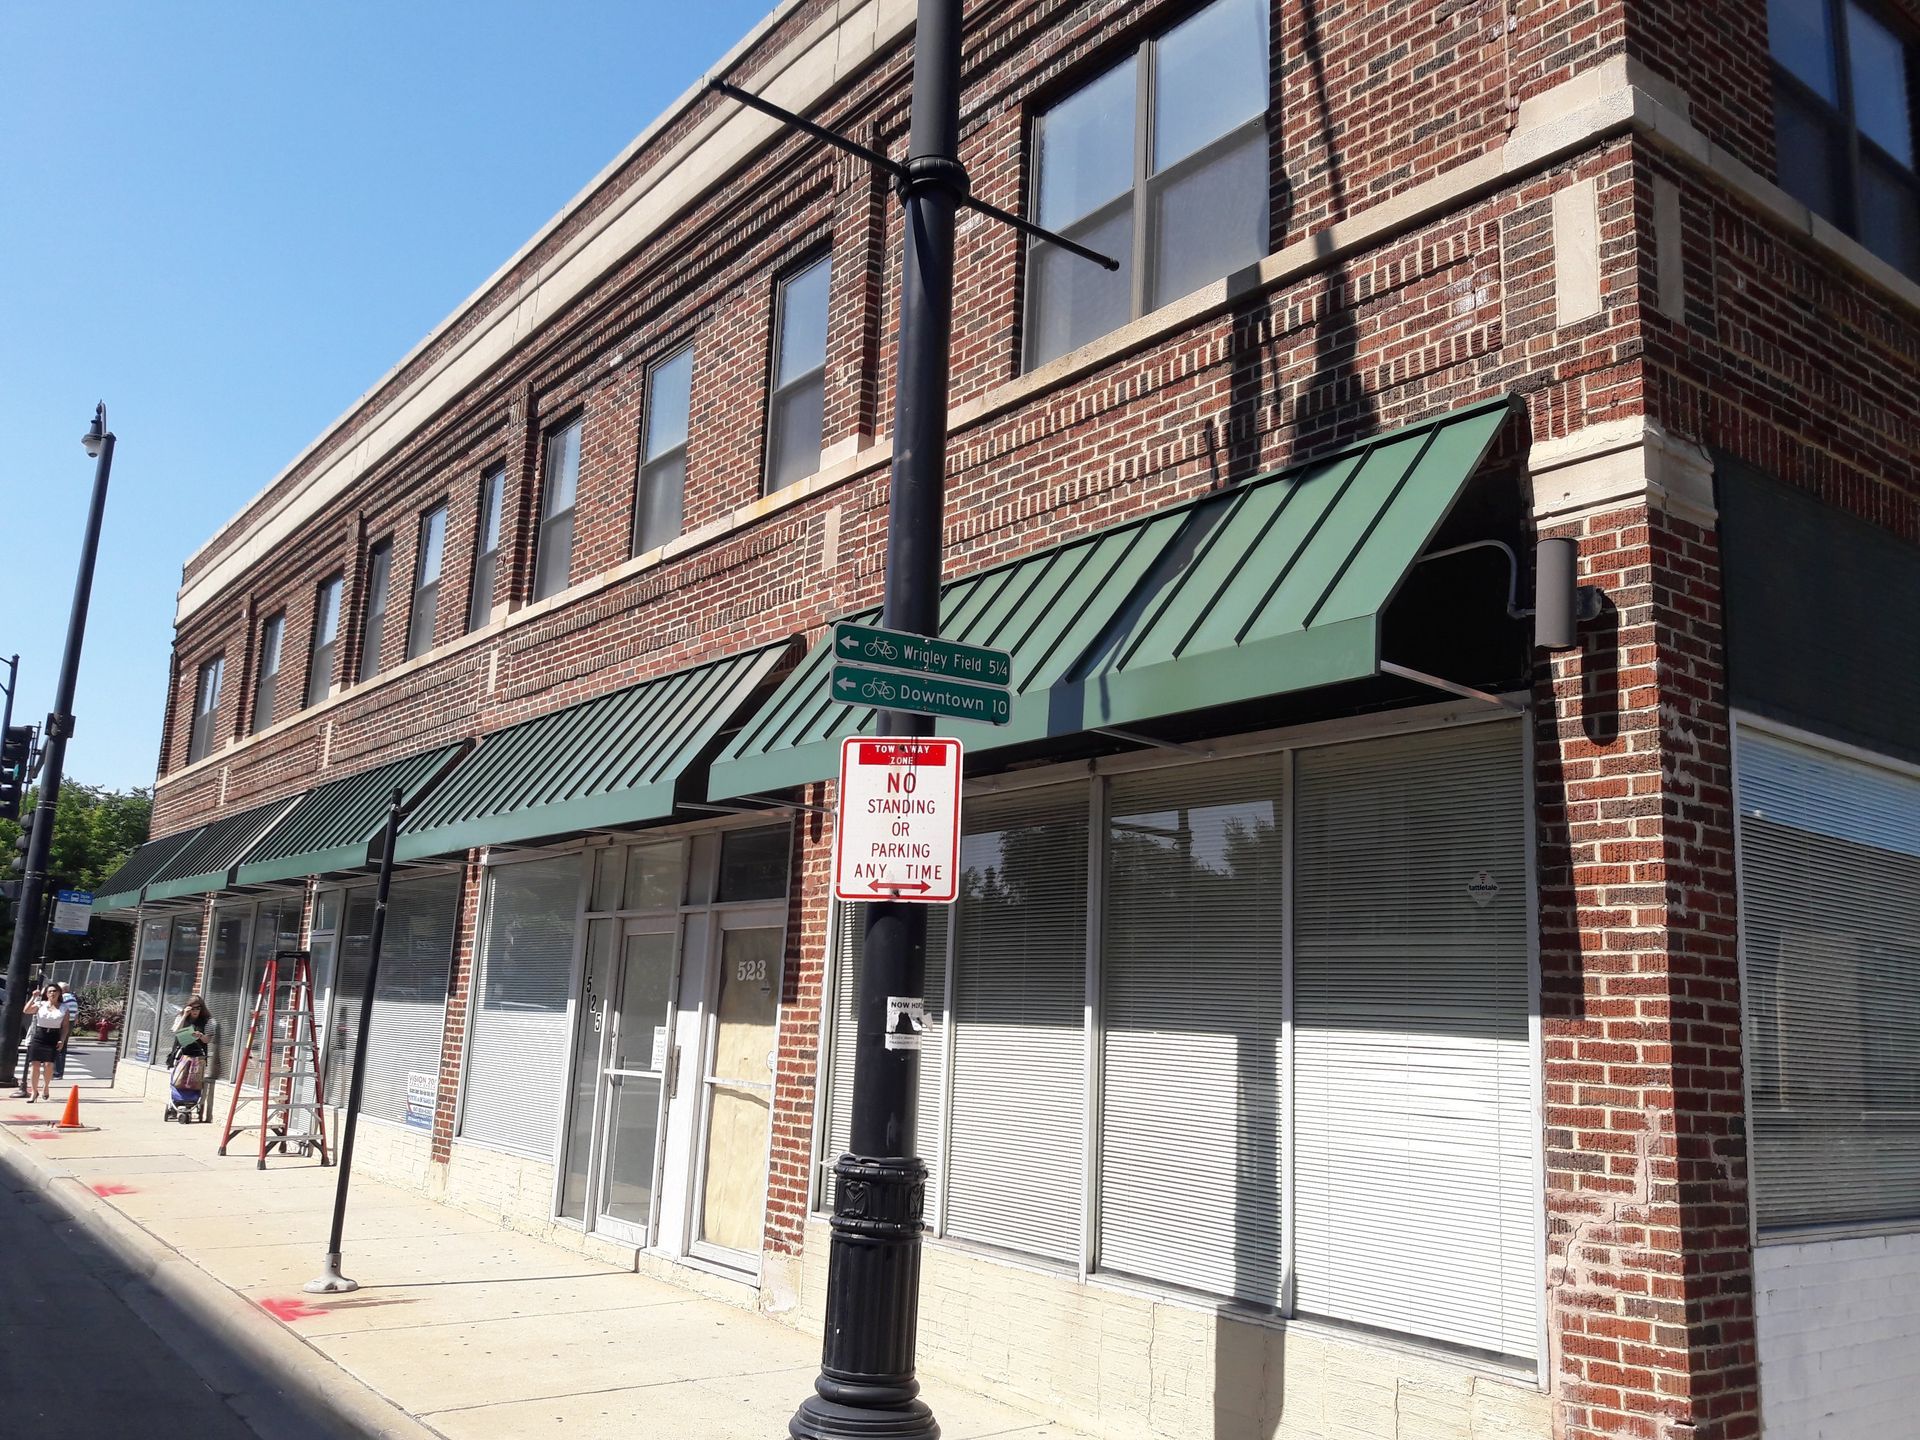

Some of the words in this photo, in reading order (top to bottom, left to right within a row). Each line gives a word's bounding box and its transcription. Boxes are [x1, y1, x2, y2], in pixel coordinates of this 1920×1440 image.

[903, 644, 948, 669] Wrigley
[953, 653, 982, 672] Field
[900, 684, 984, 711] Downtown
[992, 699, 1007, 715] 10
[874, 745, 896, 753] TOW
[889, 756, 914, 765] ZONE
[887, 772, 916, 794] NO
[867, 799, 936, 815] STANDING
[891, 822, 910, 837] OR
[871, 842, 930, 858] PARKING
[854, 863, 887, 878] ANY
[906, 864, 942, 880] TIME
[736, 960, 767, 981] 523
[891, 1001, 910, 1009] NOW
